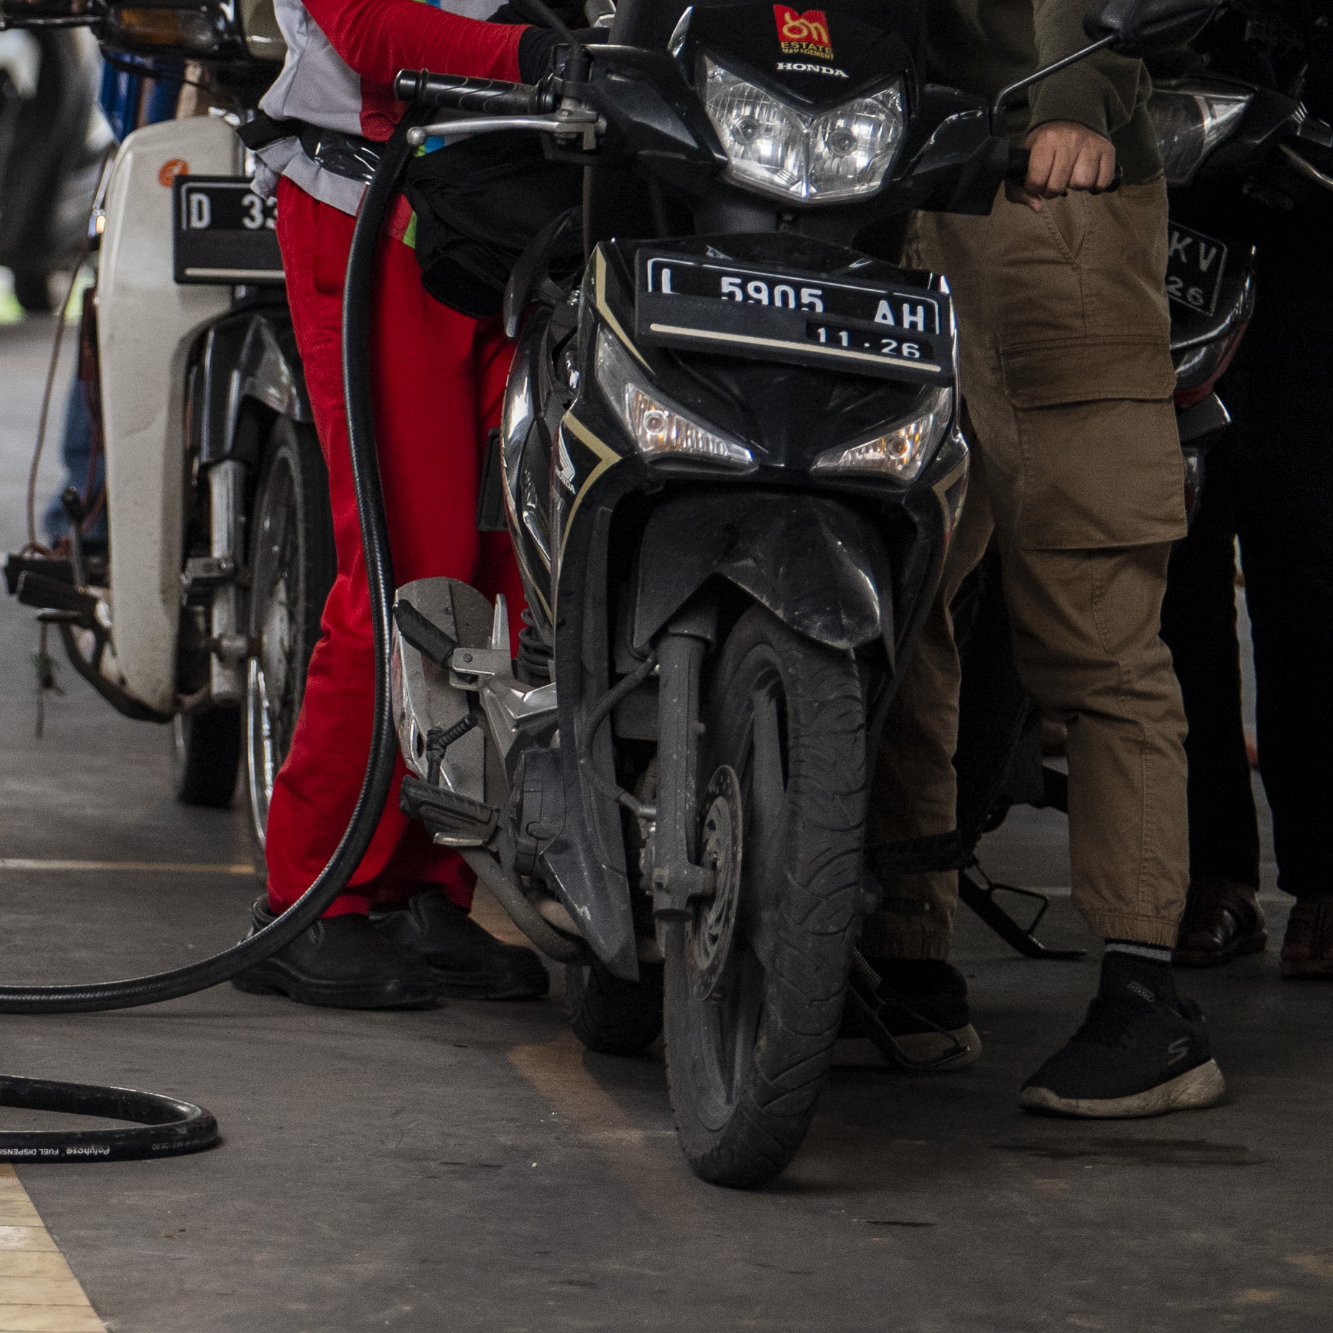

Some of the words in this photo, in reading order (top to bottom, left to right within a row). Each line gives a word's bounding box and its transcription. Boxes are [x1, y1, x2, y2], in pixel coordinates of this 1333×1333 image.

[780, 41, 833, 55] ESTATE
[781, 48, 835, 61] MANAGEMENT
[776, 62, 850, 78] HONDA
[189, 192, 212, 229] D
[873, 298, 925, 333] AH
[65, 1145, 110, 1155] Polyhose
